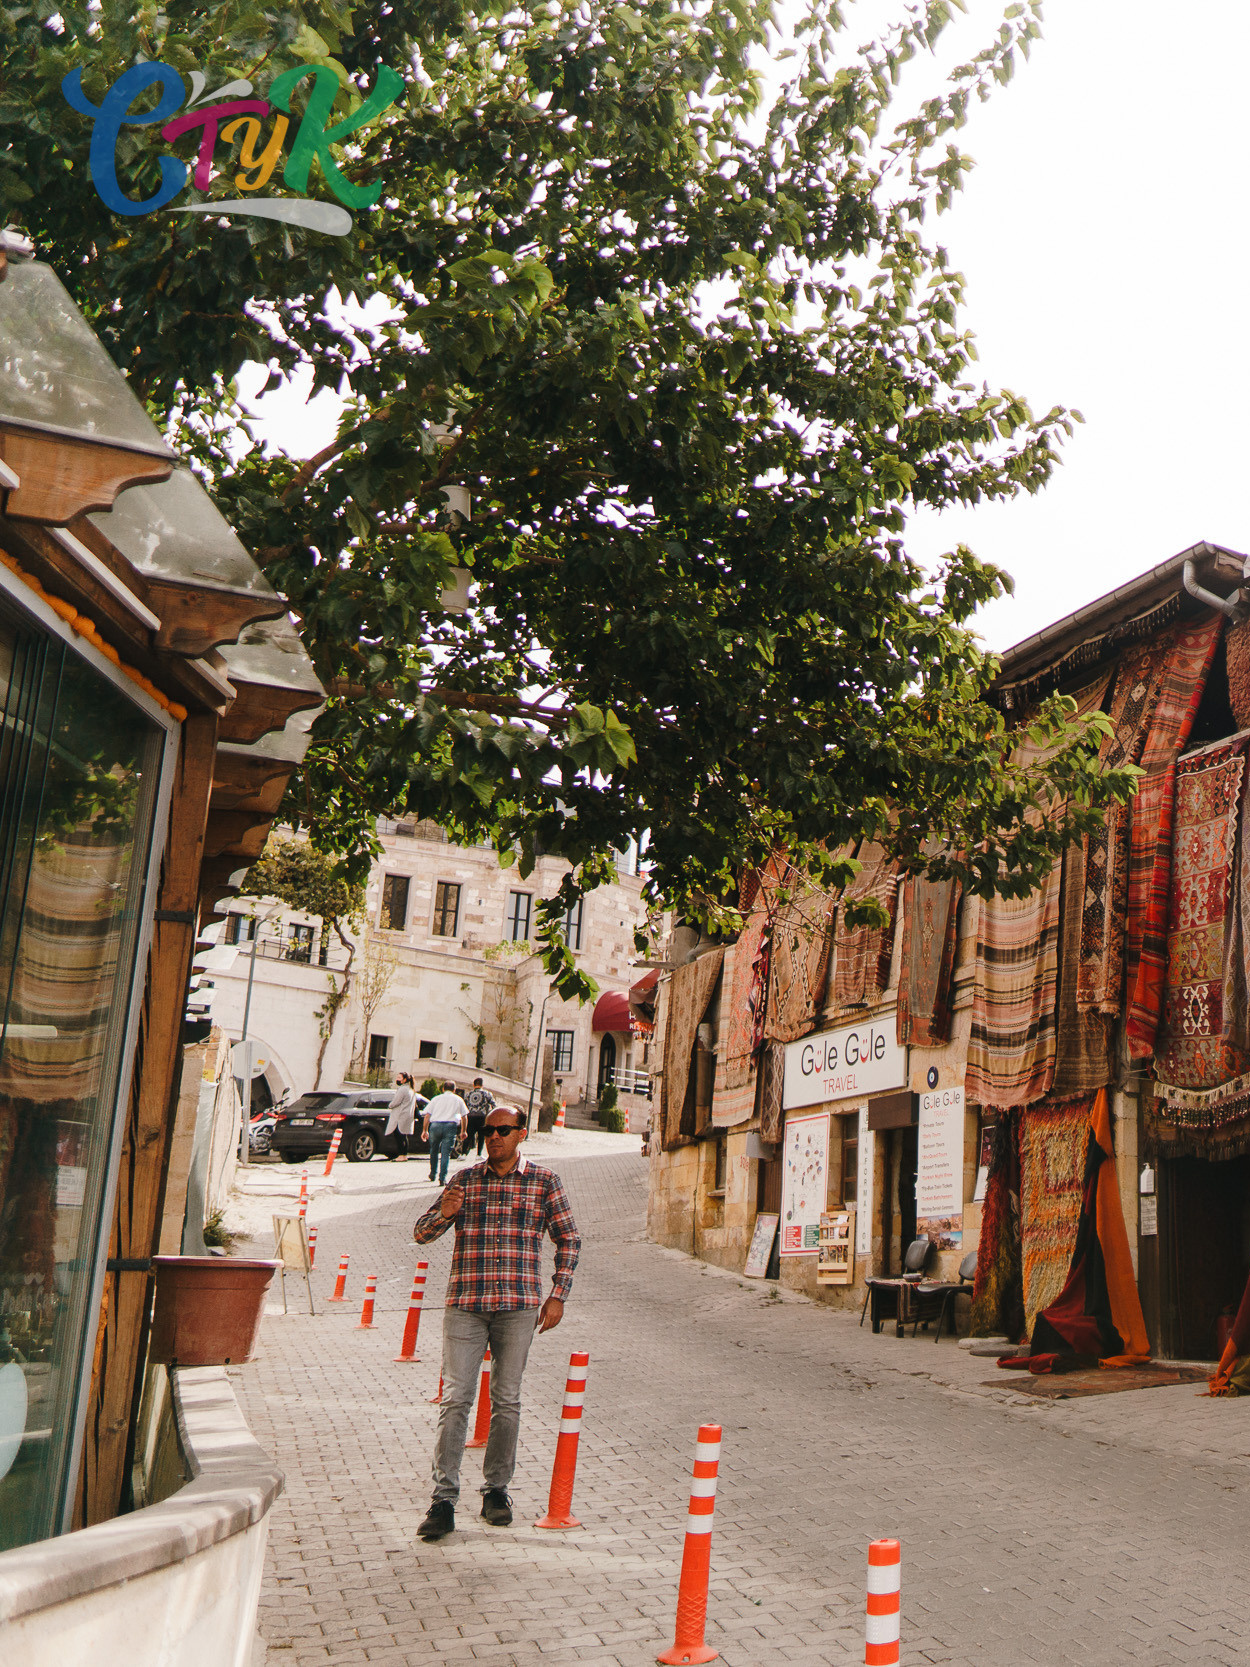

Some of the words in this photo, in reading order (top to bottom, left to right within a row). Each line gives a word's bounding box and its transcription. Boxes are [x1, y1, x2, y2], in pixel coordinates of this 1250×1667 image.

[449, 1045, 459, 1061] 12
[801, 1040, 838, 1077] Güle
[844, 1028, 886, 1066] Güle
[823, 1073, 859, 1096] TRAVEL
